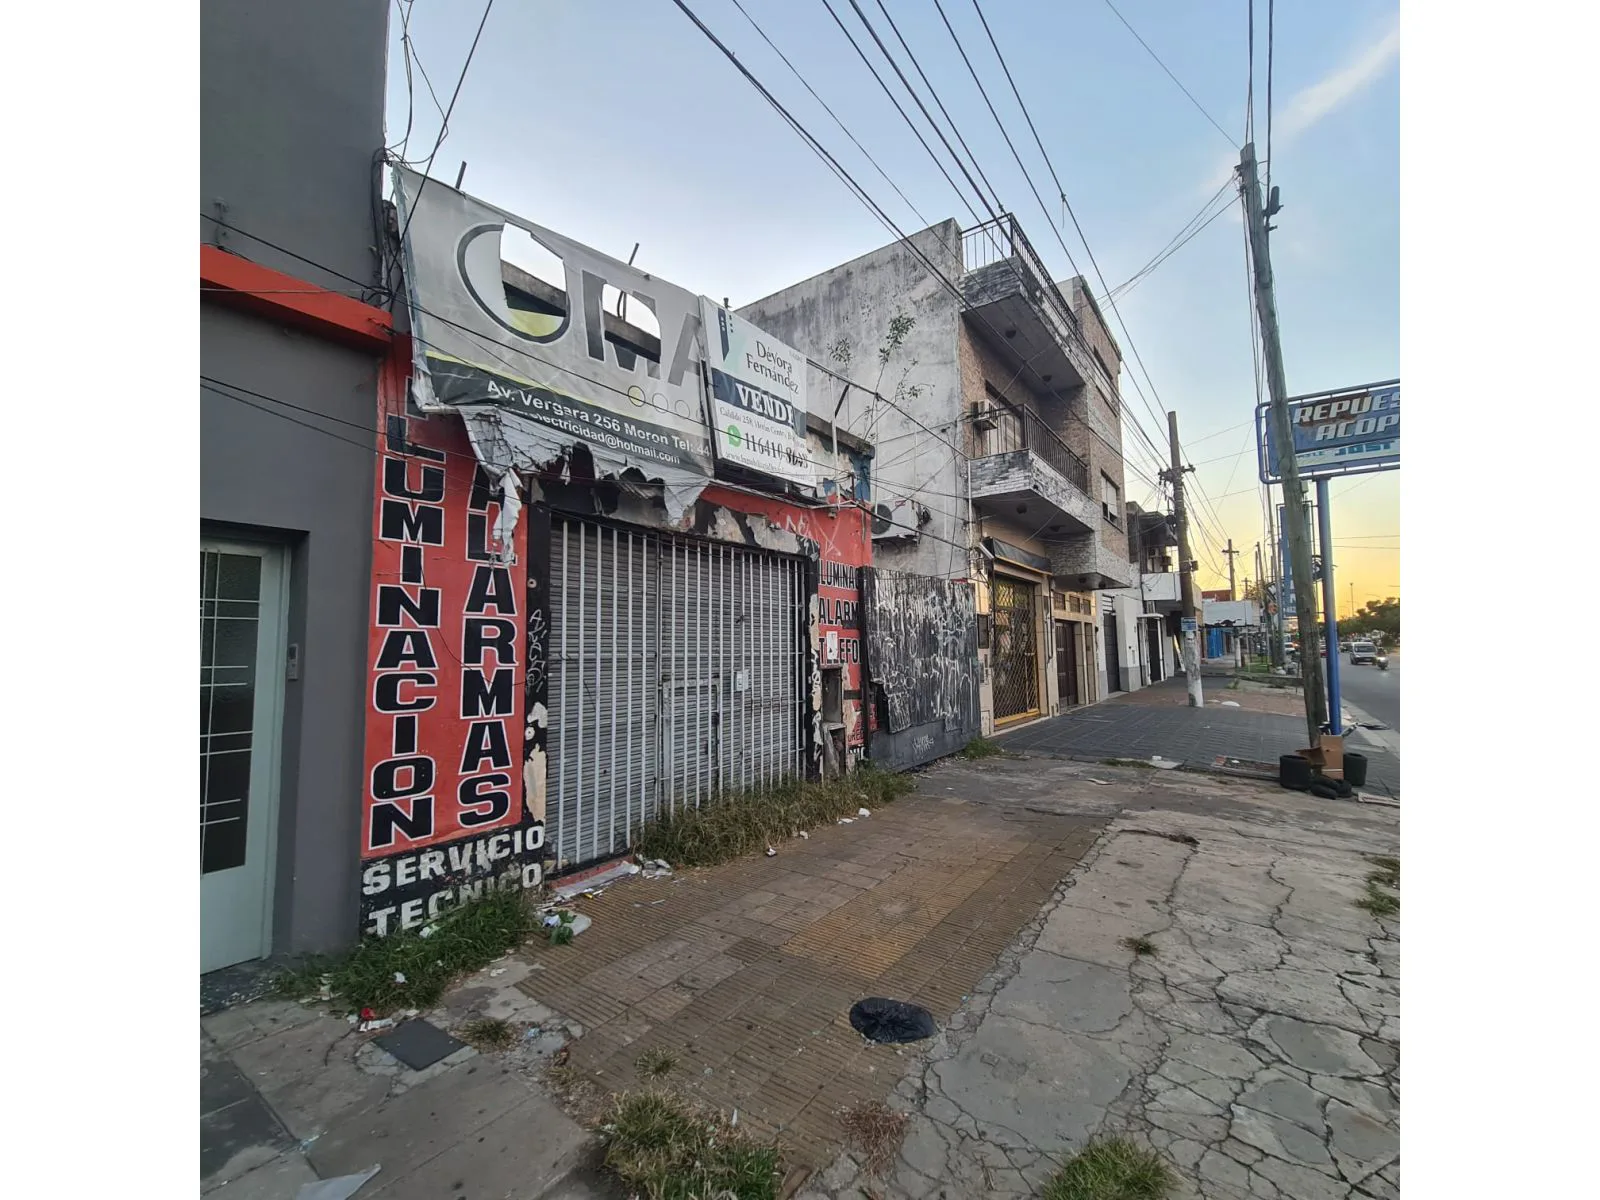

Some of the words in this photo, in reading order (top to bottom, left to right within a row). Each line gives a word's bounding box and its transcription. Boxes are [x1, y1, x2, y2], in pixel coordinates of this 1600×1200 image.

[487, 379, 515, 401] Av.
[519, 389, 590, 423] Vergara
[593, 413, 621, 433] 256
[623, 422, 669, 446] Moron
[456, 460, 518, 829] ALARMAS
[362, 825, 546, 896] SERVICIO
[368, 862, 543, 938] TECNICO
